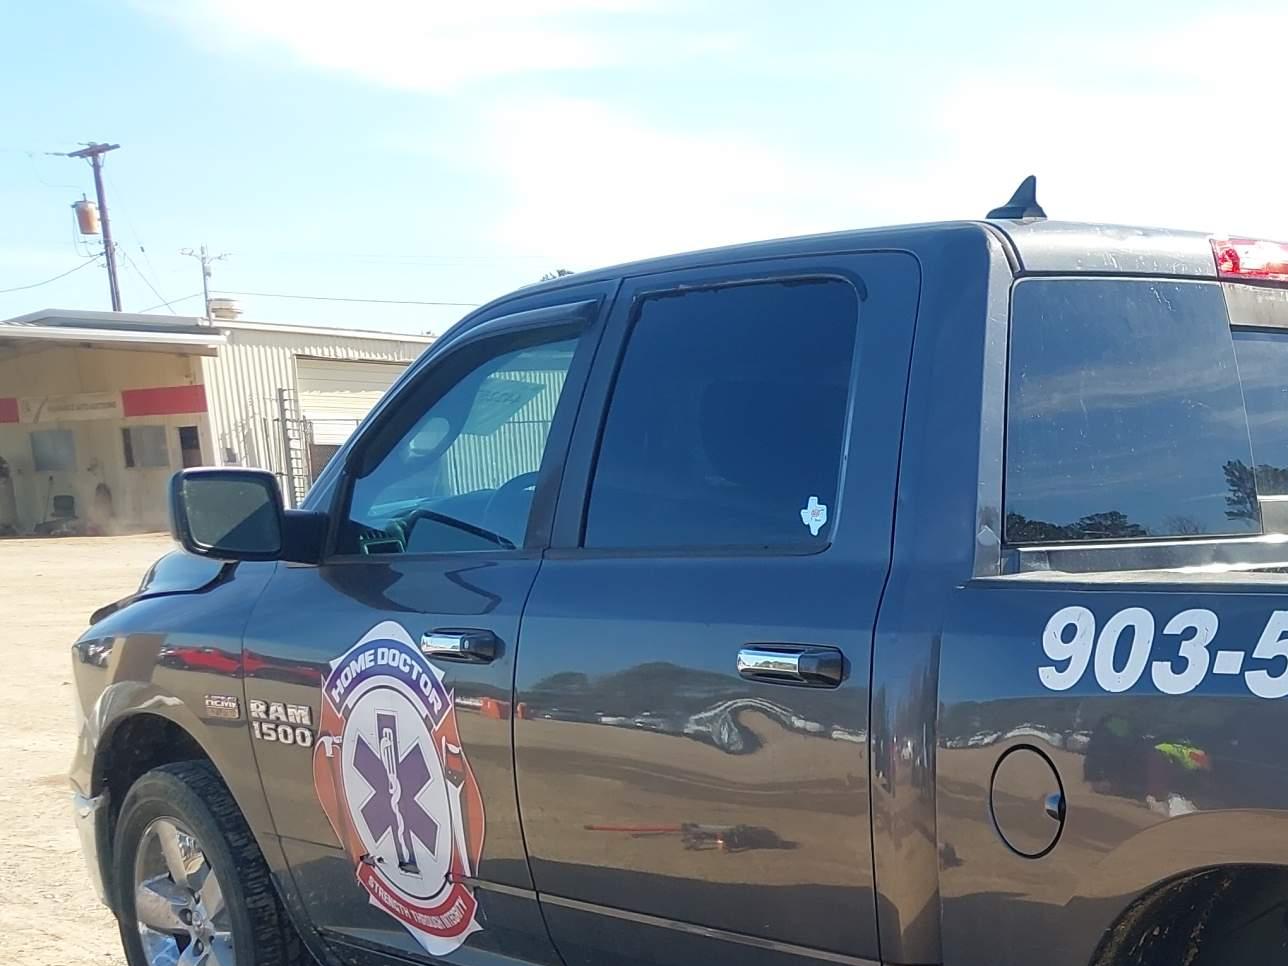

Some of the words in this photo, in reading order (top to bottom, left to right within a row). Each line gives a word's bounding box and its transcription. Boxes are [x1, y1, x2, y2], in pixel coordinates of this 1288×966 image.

[331, 649, 375, 703] HOME
[377, 647, 442, 715] DOCTOR
[250, 700, 312, 726] RAM
[252, 720, 314, 748] 1500
